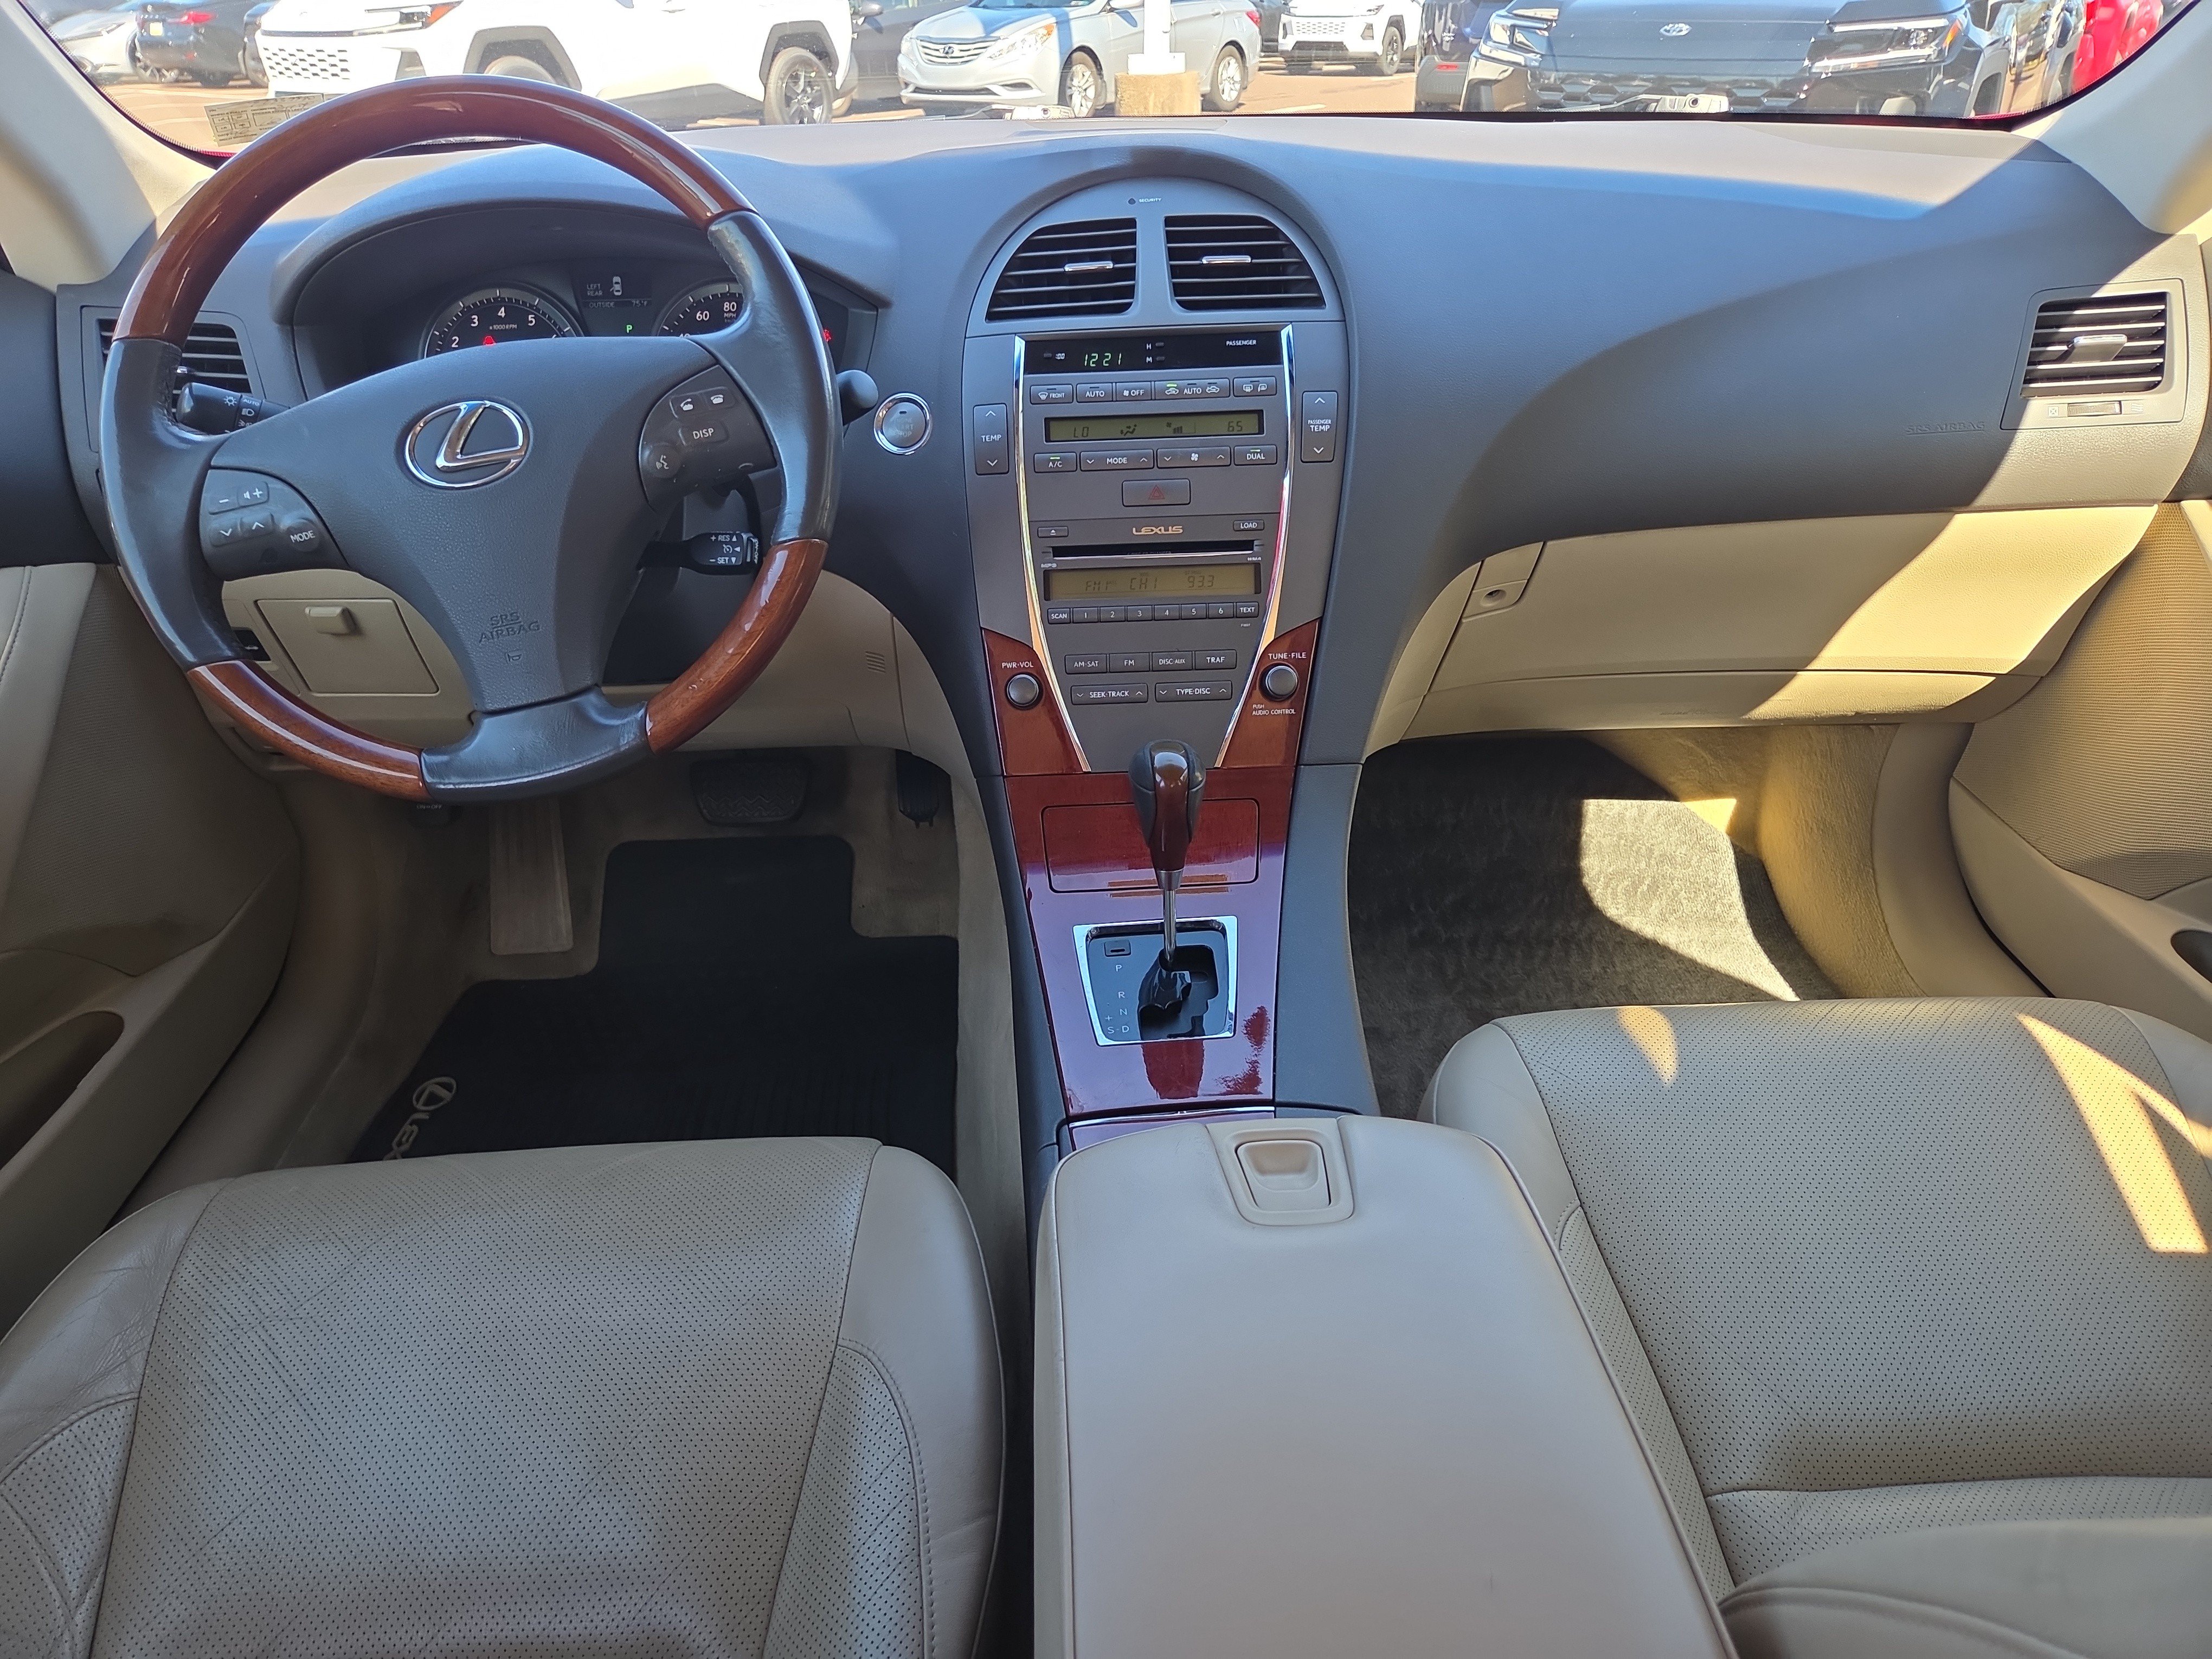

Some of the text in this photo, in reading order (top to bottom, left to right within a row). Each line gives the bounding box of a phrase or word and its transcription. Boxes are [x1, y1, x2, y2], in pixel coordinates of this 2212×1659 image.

[498, 306, 506, 318] 4
[723, 301, 737, 312] 80
[471, 315, 479, 327] 3
[528, 314, 536, 326] 5
[696, 311, 710, 321] 60
[626, 324, 633, 334] P
[452, 336, 459, 348] 2
[243, 397, 260, 407] AUTO
[1227, 420, 1243, 433] 65
[1904, 420, 1985, 433] SRS AIRBAG
[692, 427, 715, 440] DISP
[981, 433, 1002, 442] TEMP
[1133, 525, 1183, 535] LEXUS
[290, 530, 316, 544] MODE
[490, 612, 519, 626] SRS
[479, 620, 540, 644] AIRBAG
[1115, 964, 1122, 972] P
[1120, 1008, 1128, 1016] N
